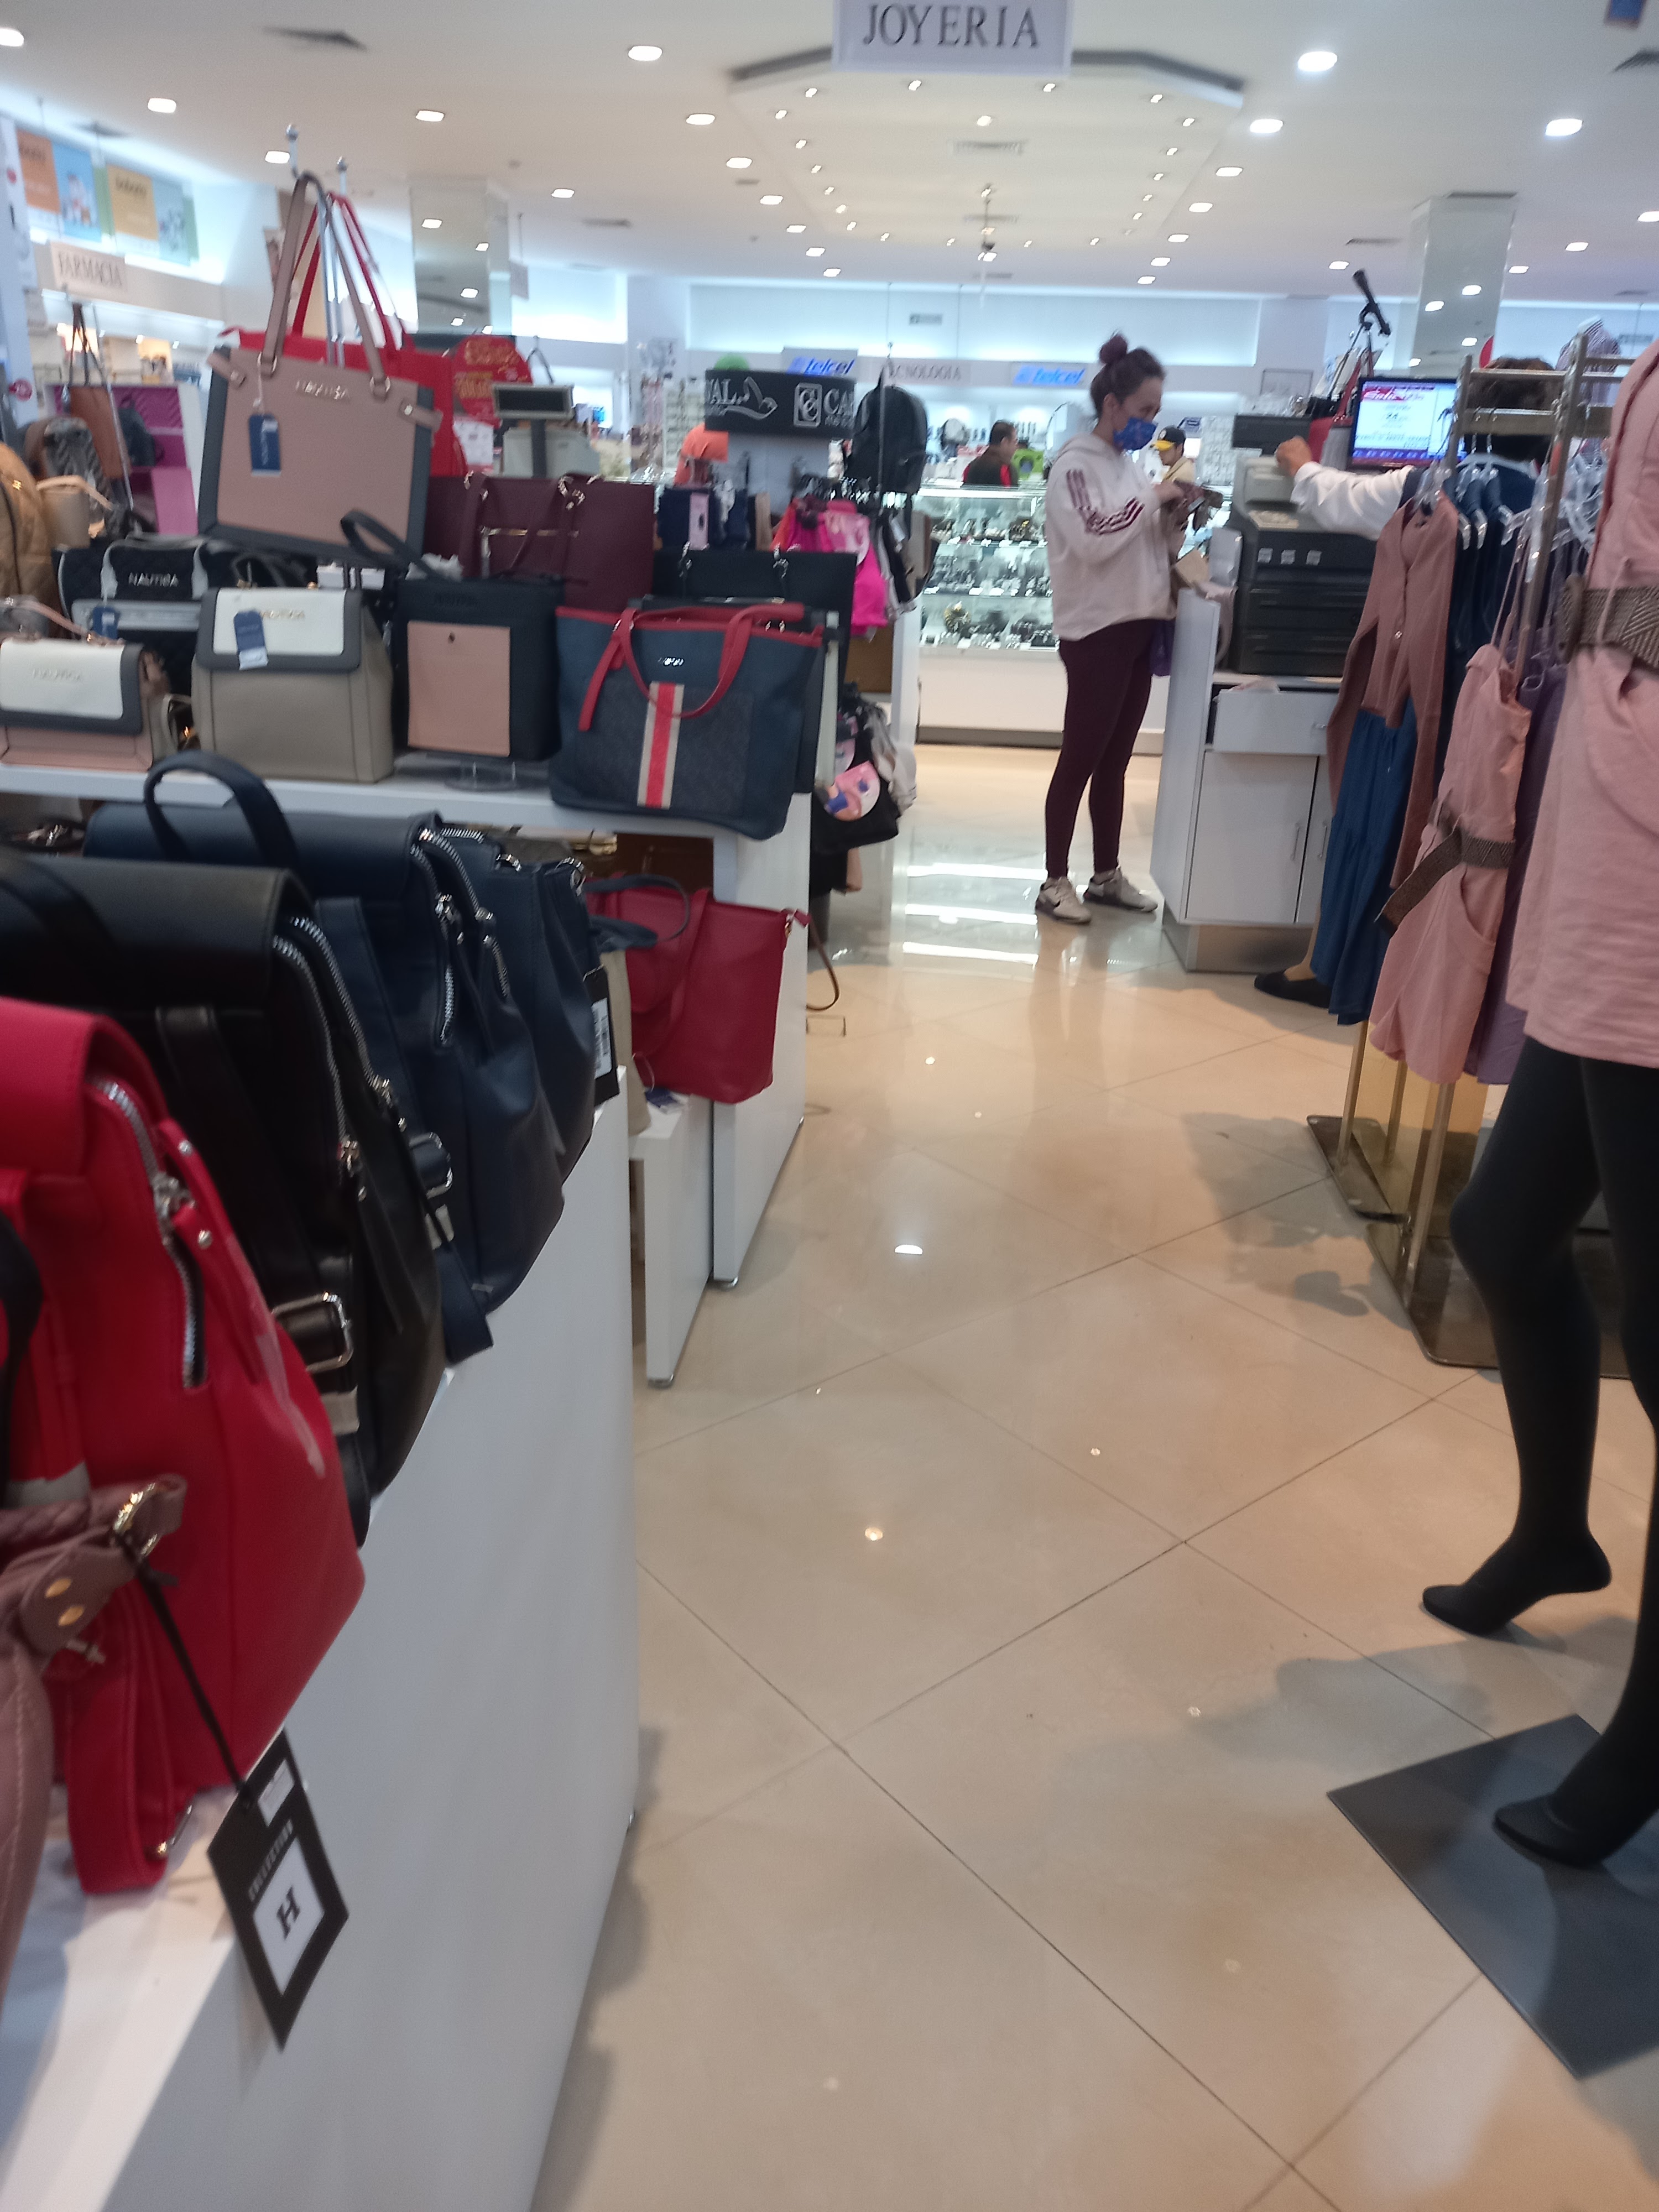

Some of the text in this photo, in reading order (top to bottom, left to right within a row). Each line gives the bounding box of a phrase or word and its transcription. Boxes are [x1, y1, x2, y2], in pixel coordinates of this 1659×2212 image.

[863, 4, 1038, 48] JOYERIA
[58, 252, 123, 287] FARMACIA
[1032, 367, 1086, 385] telcel
[128, 572, 179, 587] NAUTICA
[276, 1885, 300, 1940] H
